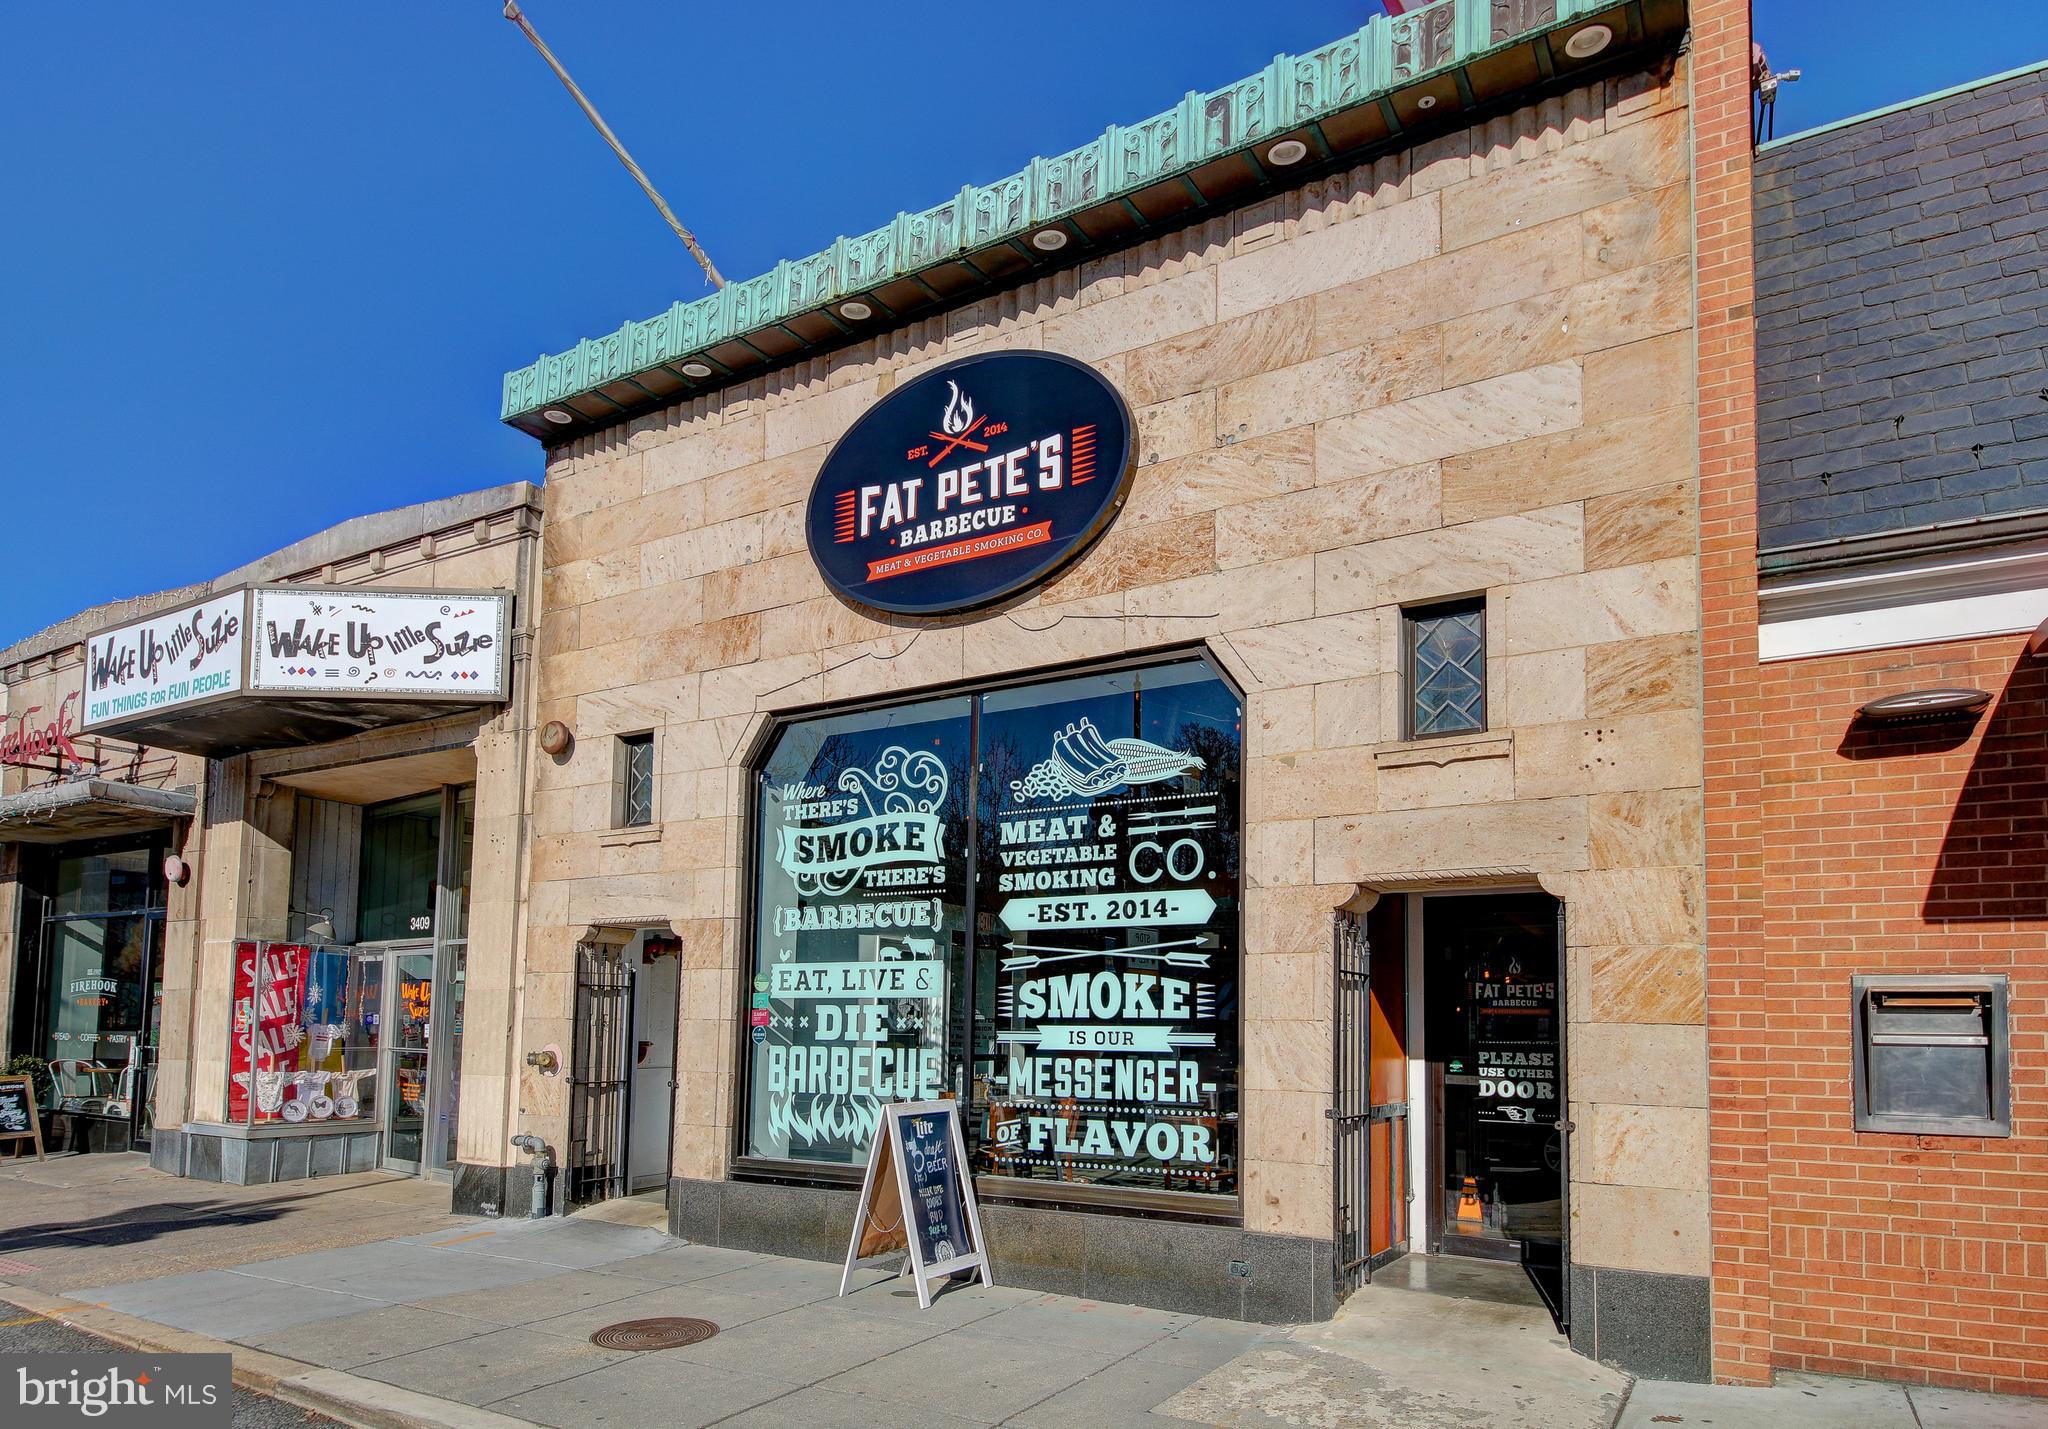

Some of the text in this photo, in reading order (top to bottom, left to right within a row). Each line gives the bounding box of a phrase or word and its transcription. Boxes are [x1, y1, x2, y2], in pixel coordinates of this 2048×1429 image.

[983, 422, 1009, 438] 2014
[907, 446, 929, 460] EST.
[859, 432, 1064, 538] FAT PETE'S
[900, 505, 1016, 548] BARBECUE
[875, 528, 1045, 575] MEAT & VEGETABLE SMOKING CO.
[346, 620, 384, 666] Up
[139, 628, 164, 685] Up
[91, 669, 232, 720] FUN THINGS FOR FUN PEOPLE
[783, 781, 826, 800] Where
[783, 798, 859, 821] THERE'S
[1000, 814, 1117, 845] MEAT &
[793, 821, 926, 865] SMOKE
[1000, 838, 1217, 884] VEGETABLE CO.
[863, 865, 946, 887] THERE'S
[999, 867, 1116, 892] SMOKING
[410, 916, 430, 930] 3409
[70, 980, 118, 993] FIREHOOK
[778, 967, 932, 993] EAT, LIVE &
[1475, 982, 1500, 999] FAT
[1018, 971, 1190, 1020] SMOKE
[814, 1004, 889, 1042] DIE
[80, 1033, 98, 1042] COFFEE
[1069, 1031, 1135, 1046] IS OUR
[1478, 1052, 1554, 1066] PLEASE
[768, 1045, 939, 1099] BARBECUE
[1478, 1067, 1554, 1079] USE OTHER
[1478, 1079, 1555, 1099] DOOR
[996, 1116, 1215, 1163] OF FLAVOR
[926, 1157, 949, 1173] BEER
